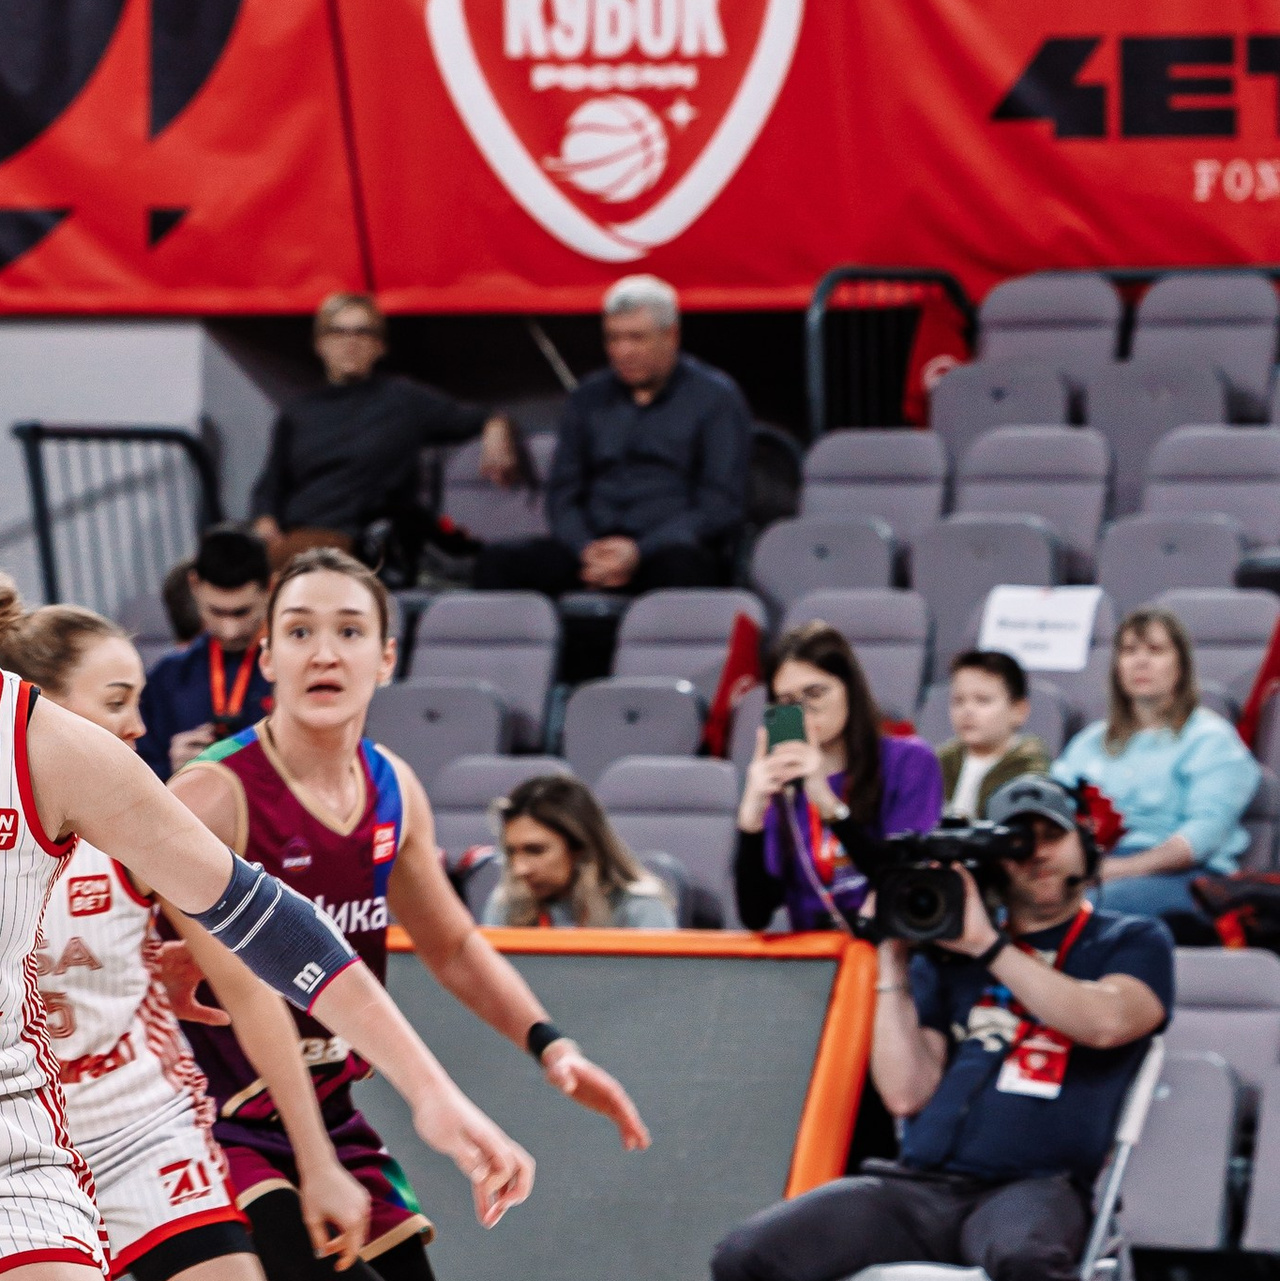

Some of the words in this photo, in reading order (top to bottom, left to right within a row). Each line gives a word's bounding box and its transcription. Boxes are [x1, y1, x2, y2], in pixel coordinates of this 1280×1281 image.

[71, 878, 109, 896] FON
[71, 894, 110, 913] BET
[314, 895, 388, 933] ика
